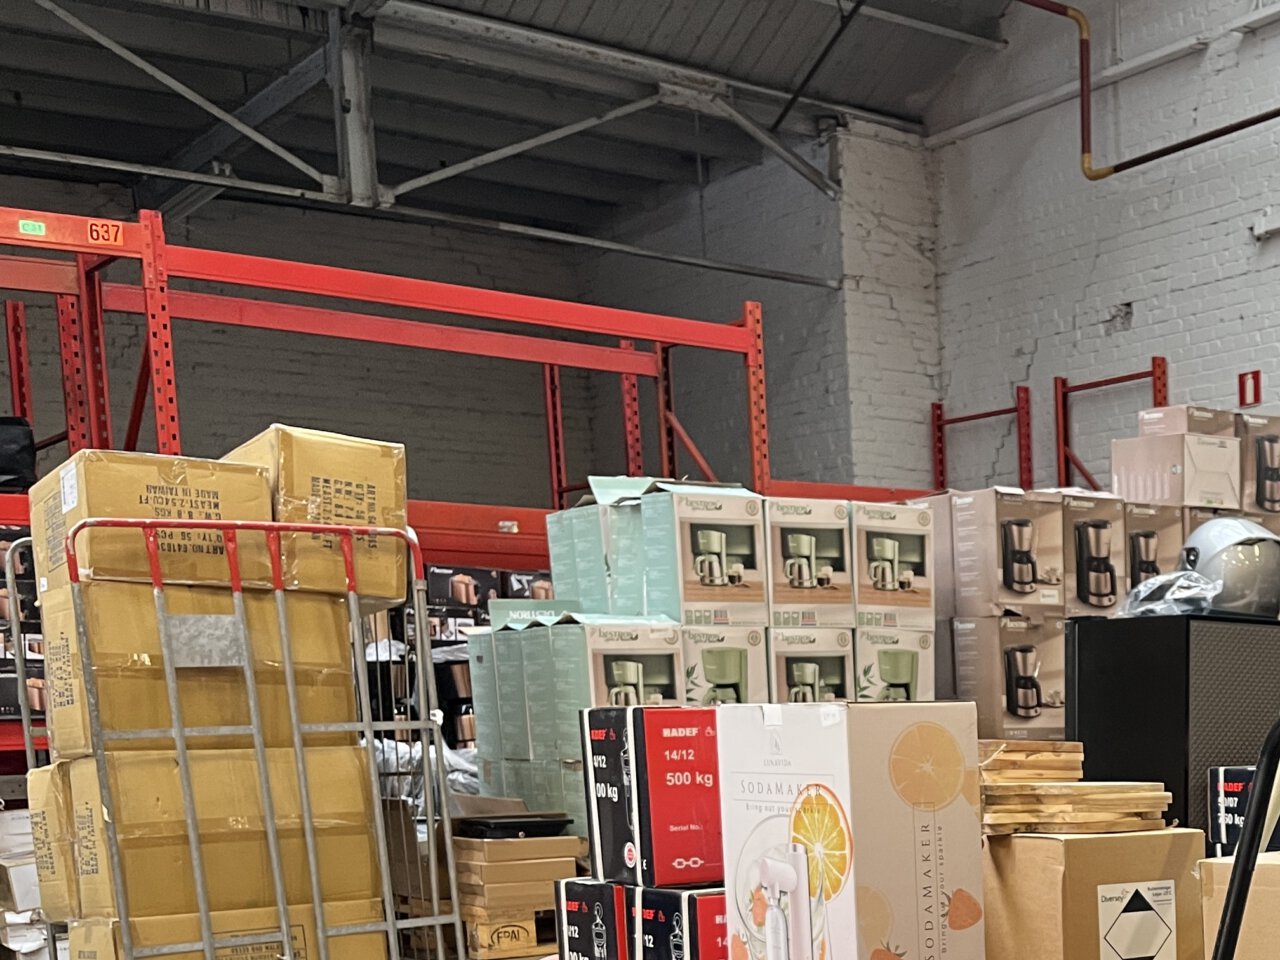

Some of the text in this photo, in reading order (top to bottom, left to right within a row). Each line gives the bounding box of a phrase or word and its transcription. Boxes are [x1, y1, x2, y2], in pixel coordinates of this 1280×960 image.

[89, 223, 120, 242] 637
[662, 727, 699, 738] HADEF
[664, 749, 695, 761] 14/12
[666, 771, 714, 787] 500 kg
[596, 782, 619, 802] 00 kg
